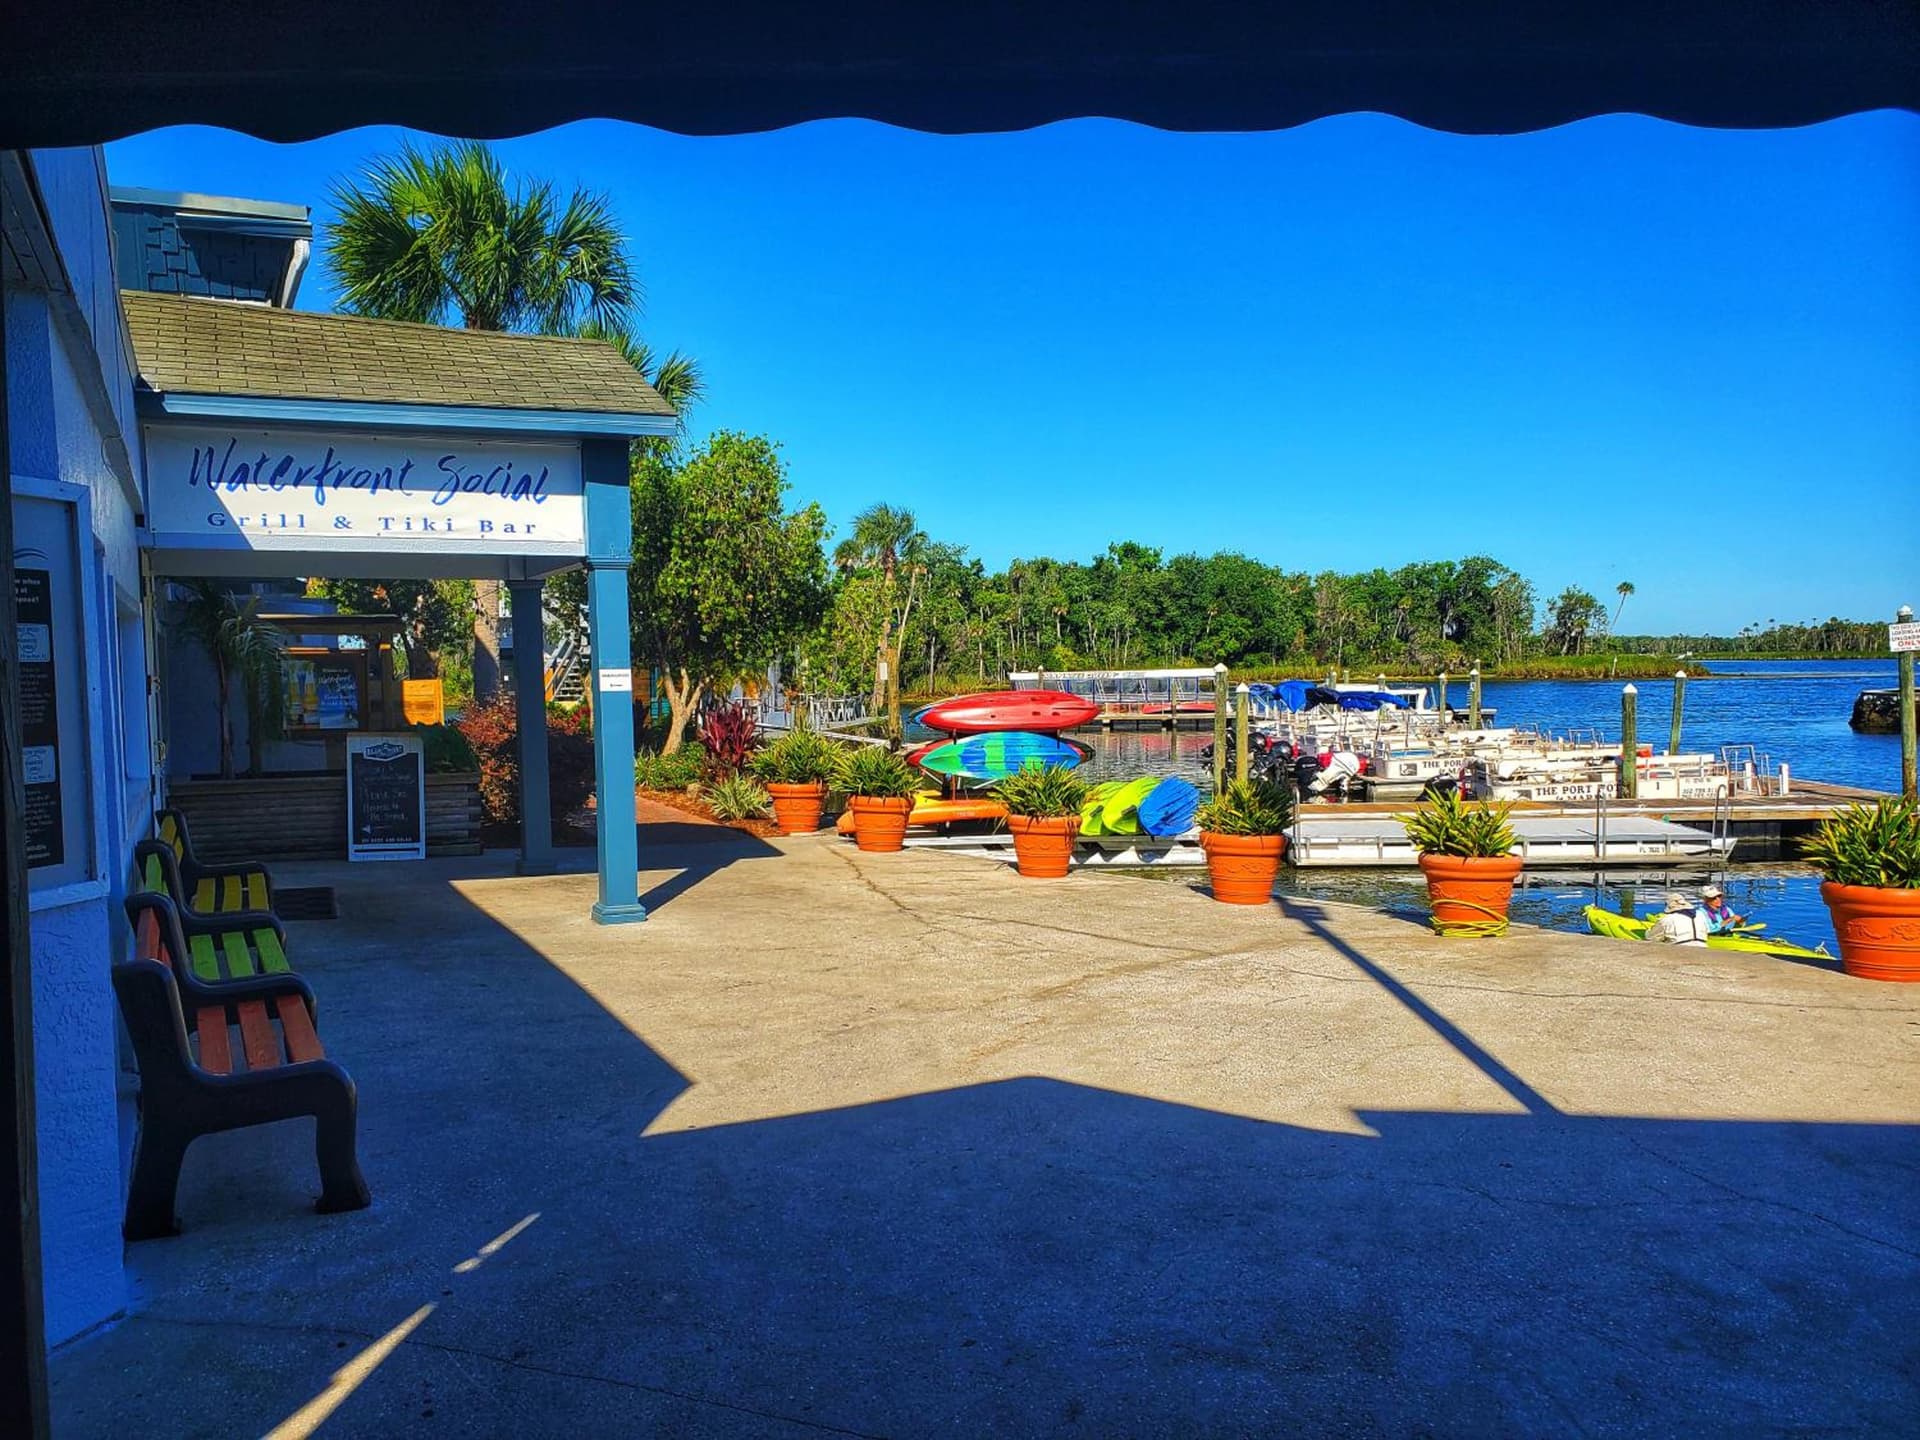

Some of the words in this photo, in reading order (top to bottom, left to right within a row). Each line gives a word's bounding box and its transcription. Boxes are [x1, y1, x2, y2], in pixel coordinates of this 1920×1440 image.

[189, 436, 415, 506] Waterfront
[431, 455, 549, 506] Social
[207, 512, 306, 528] Grill
[333, 515, 353, 530] &
[378, 516, 455, 532] Tiki
[478, 519, 537, 534] Bar
[1536, 786, 1559, 796] THE
[1562, 784, 1592, 795] PORT
